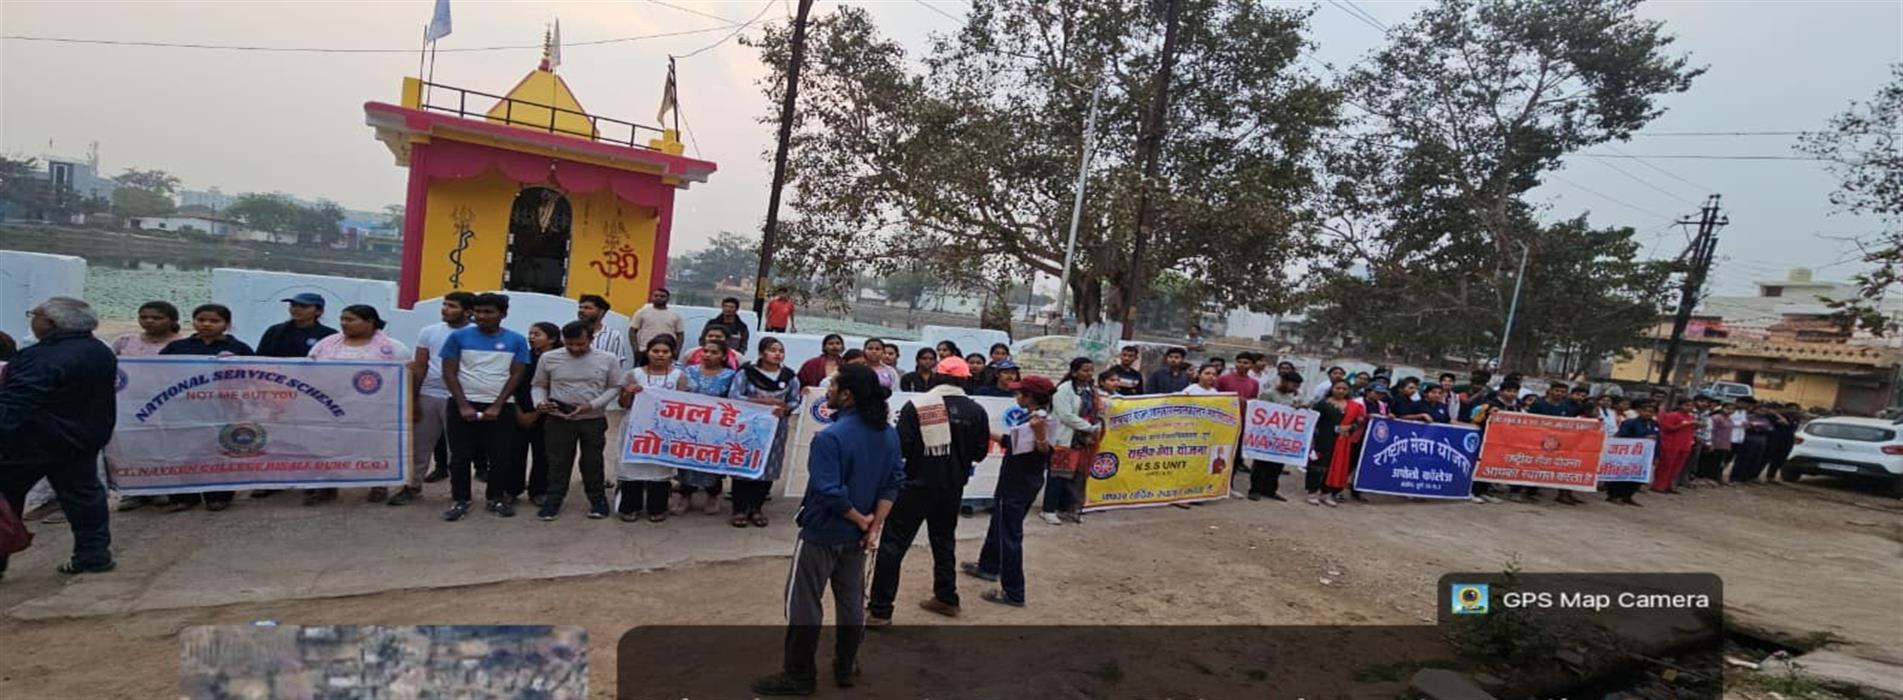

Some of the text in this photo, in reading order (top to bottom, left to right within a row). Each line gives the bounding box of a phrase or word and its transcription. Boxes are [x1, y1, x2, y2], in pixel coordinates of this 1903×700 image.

[135, 369, 346, 422] NATIONAL SERVICE SCHEME
[186, 390, 297, 401] NOT ME BUT YOU
[660, 400, 746, 433] जल है,
[1252, 408, 1306, 432] SAVE
[631, 430, 664, 456] तो
[670, 440, 724, 464] कल
[1245, 433, 1303, 453] WATER
[1372, 435, 1408, 466] राष्ट्रीय
[1410, 431, 1435, 455] सेवा
[1162, 460, 1187, 470] UNIT
